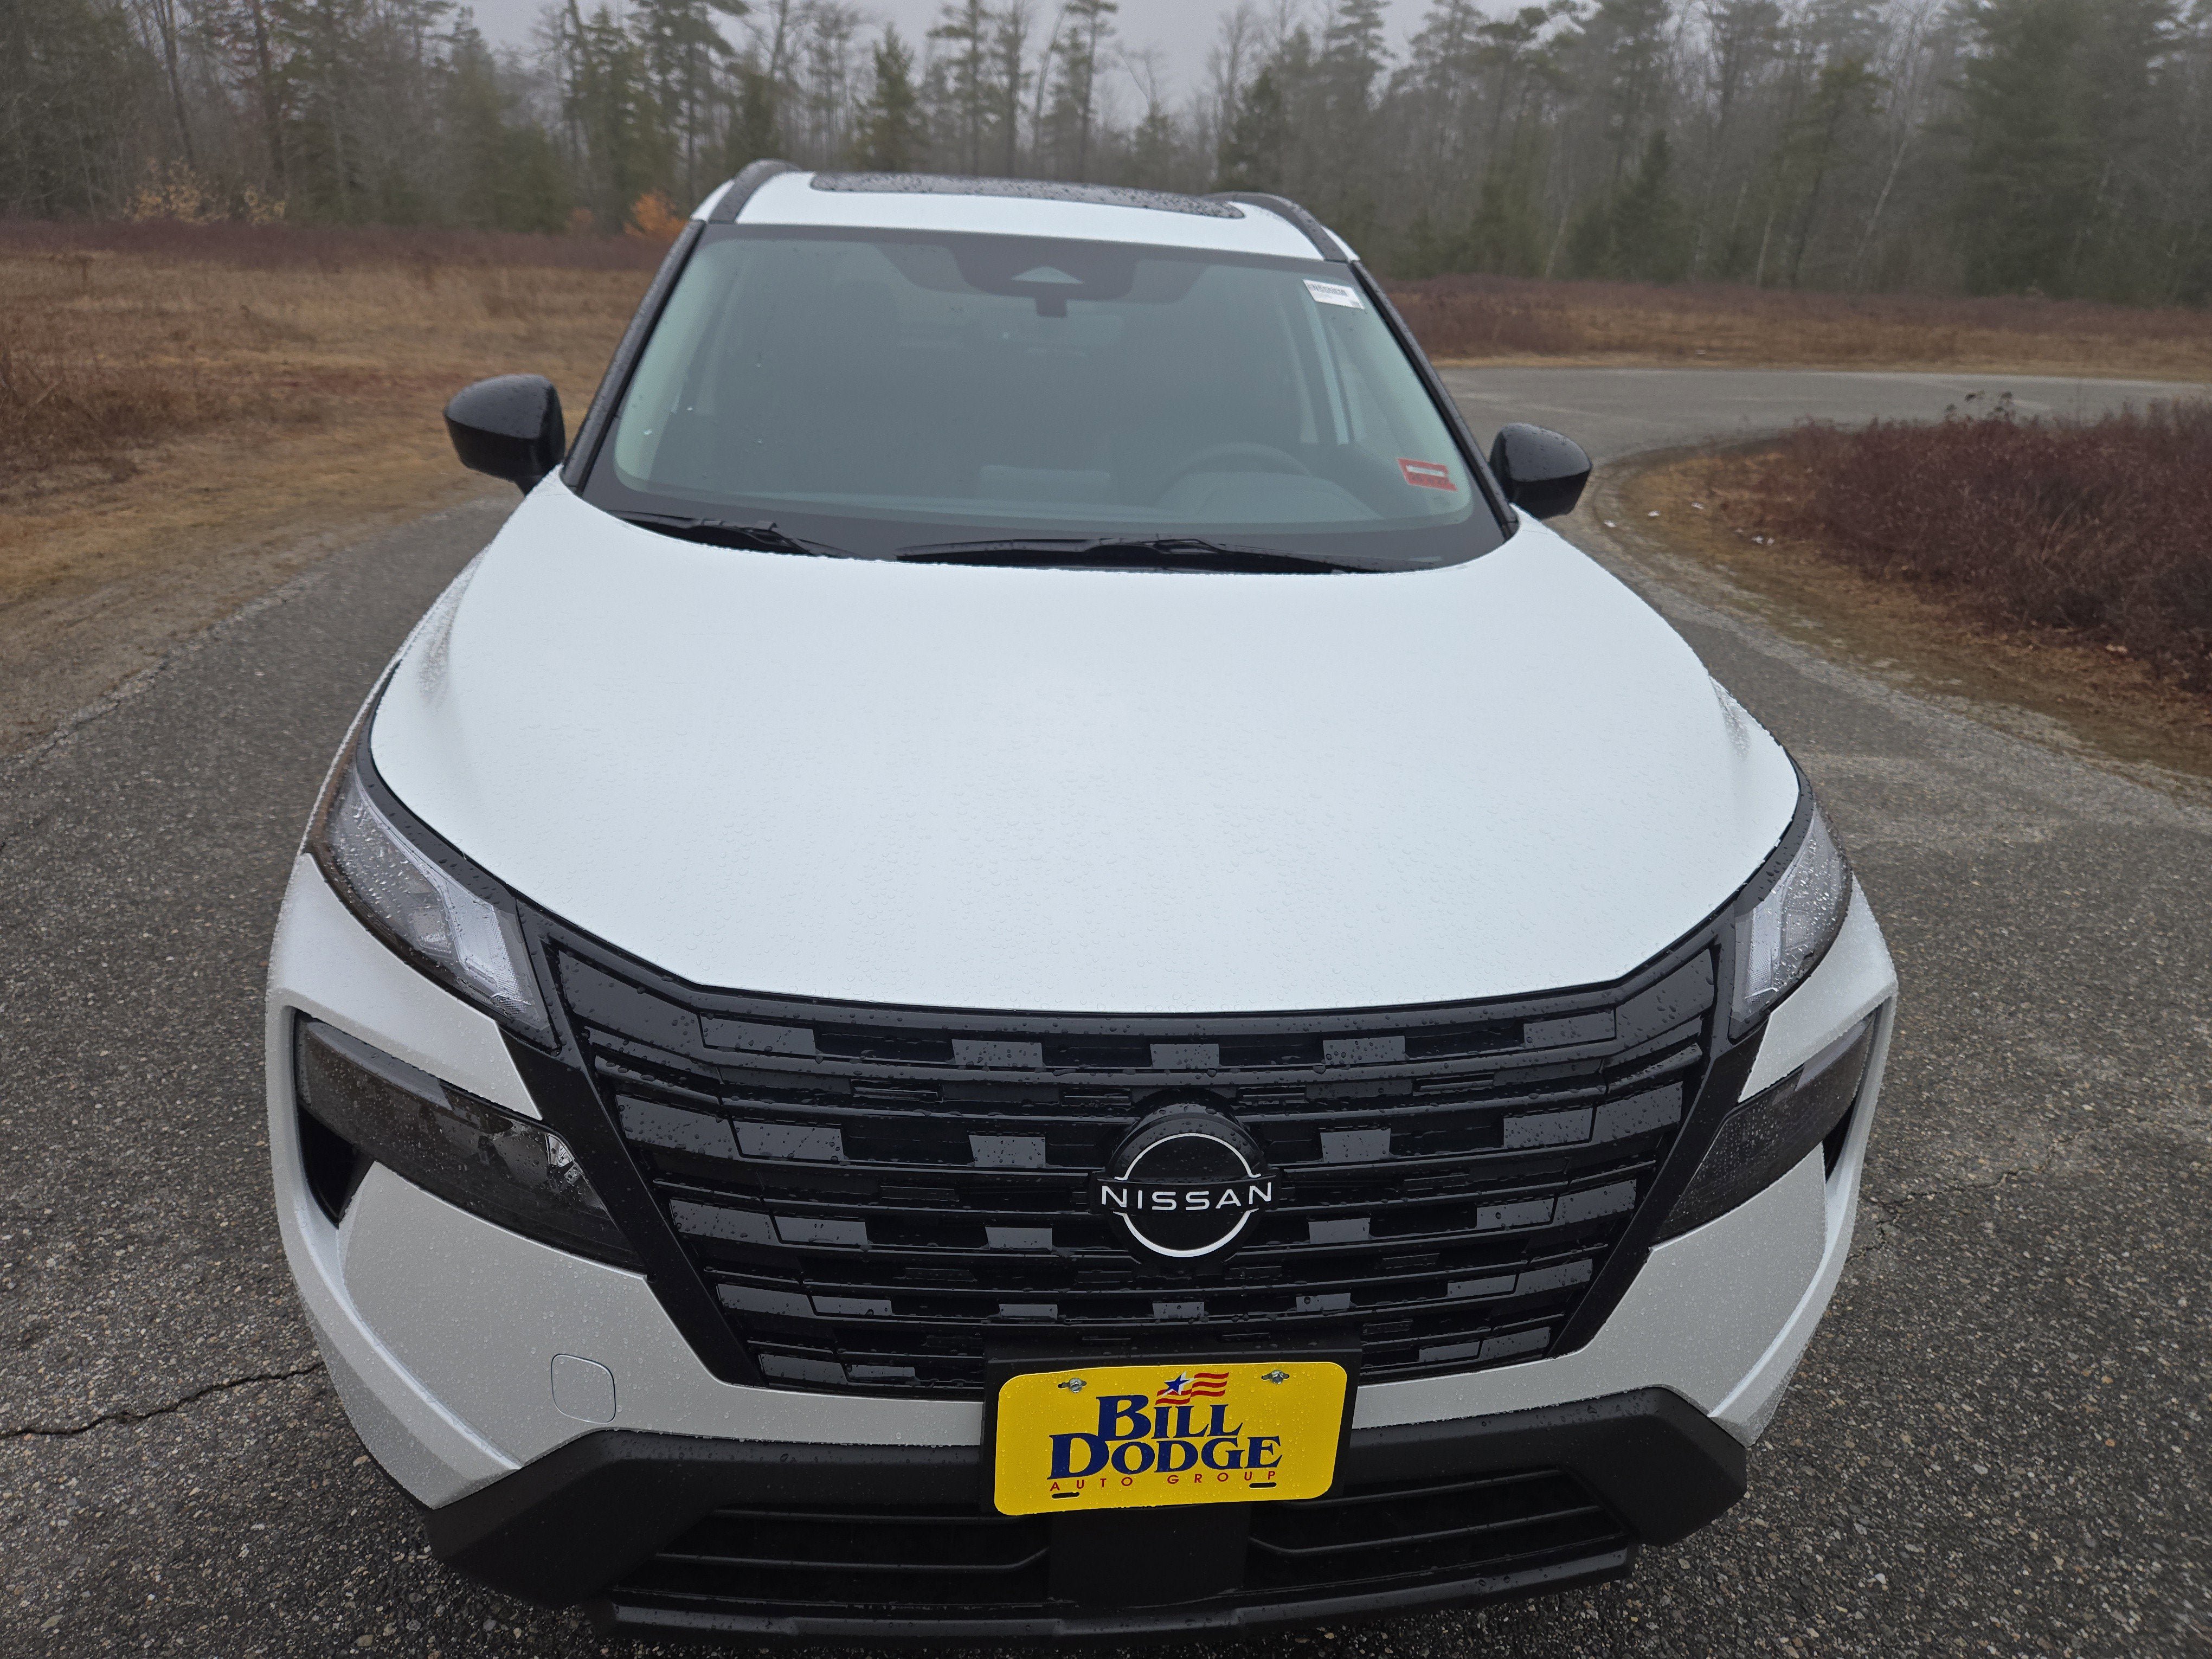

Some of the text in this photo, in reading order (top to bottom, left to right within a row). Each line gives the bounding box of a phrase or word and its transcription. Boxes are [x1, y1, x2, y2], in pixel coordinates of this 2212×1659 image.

[1102, 1182, 1272, 1211] NISSAN
[1096, 1394, 1243, 1442] BILL
[1047, 1432, 1283, 1480] DODGE
[1050, 1471, 1276, 1491] AUTO GROUP
